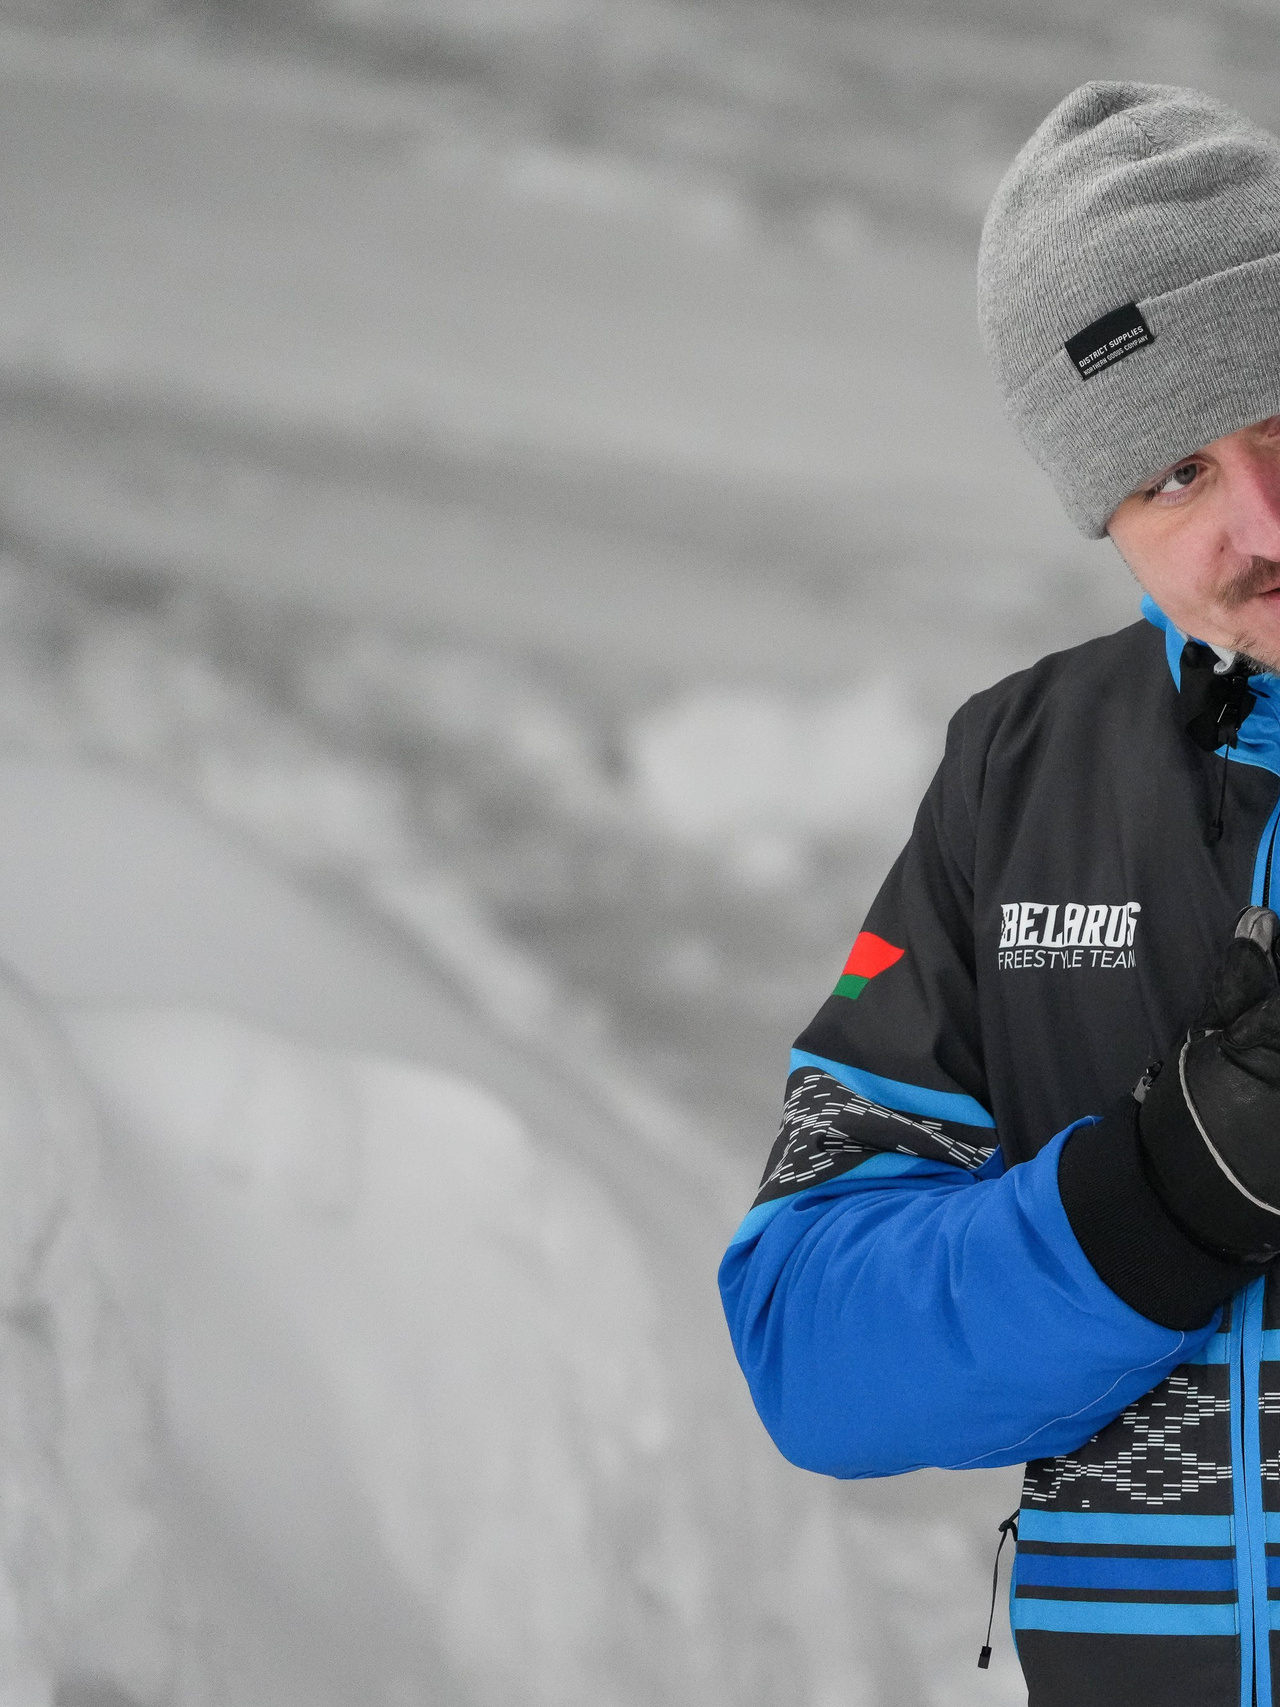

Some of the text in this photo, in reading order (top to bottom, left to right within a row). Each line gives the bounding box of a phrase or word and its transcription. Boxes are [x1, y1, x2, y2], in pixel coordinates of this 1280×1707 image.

[1078, 325, 1144, 368] DISTRICT SUPPLIES
[1083, 334, 1149, 376] NORTHERN GOODS COMPANY
[998, 901, 1142, 949] BELARUS
[998, 949, 1083, 970] FREESTYLE
